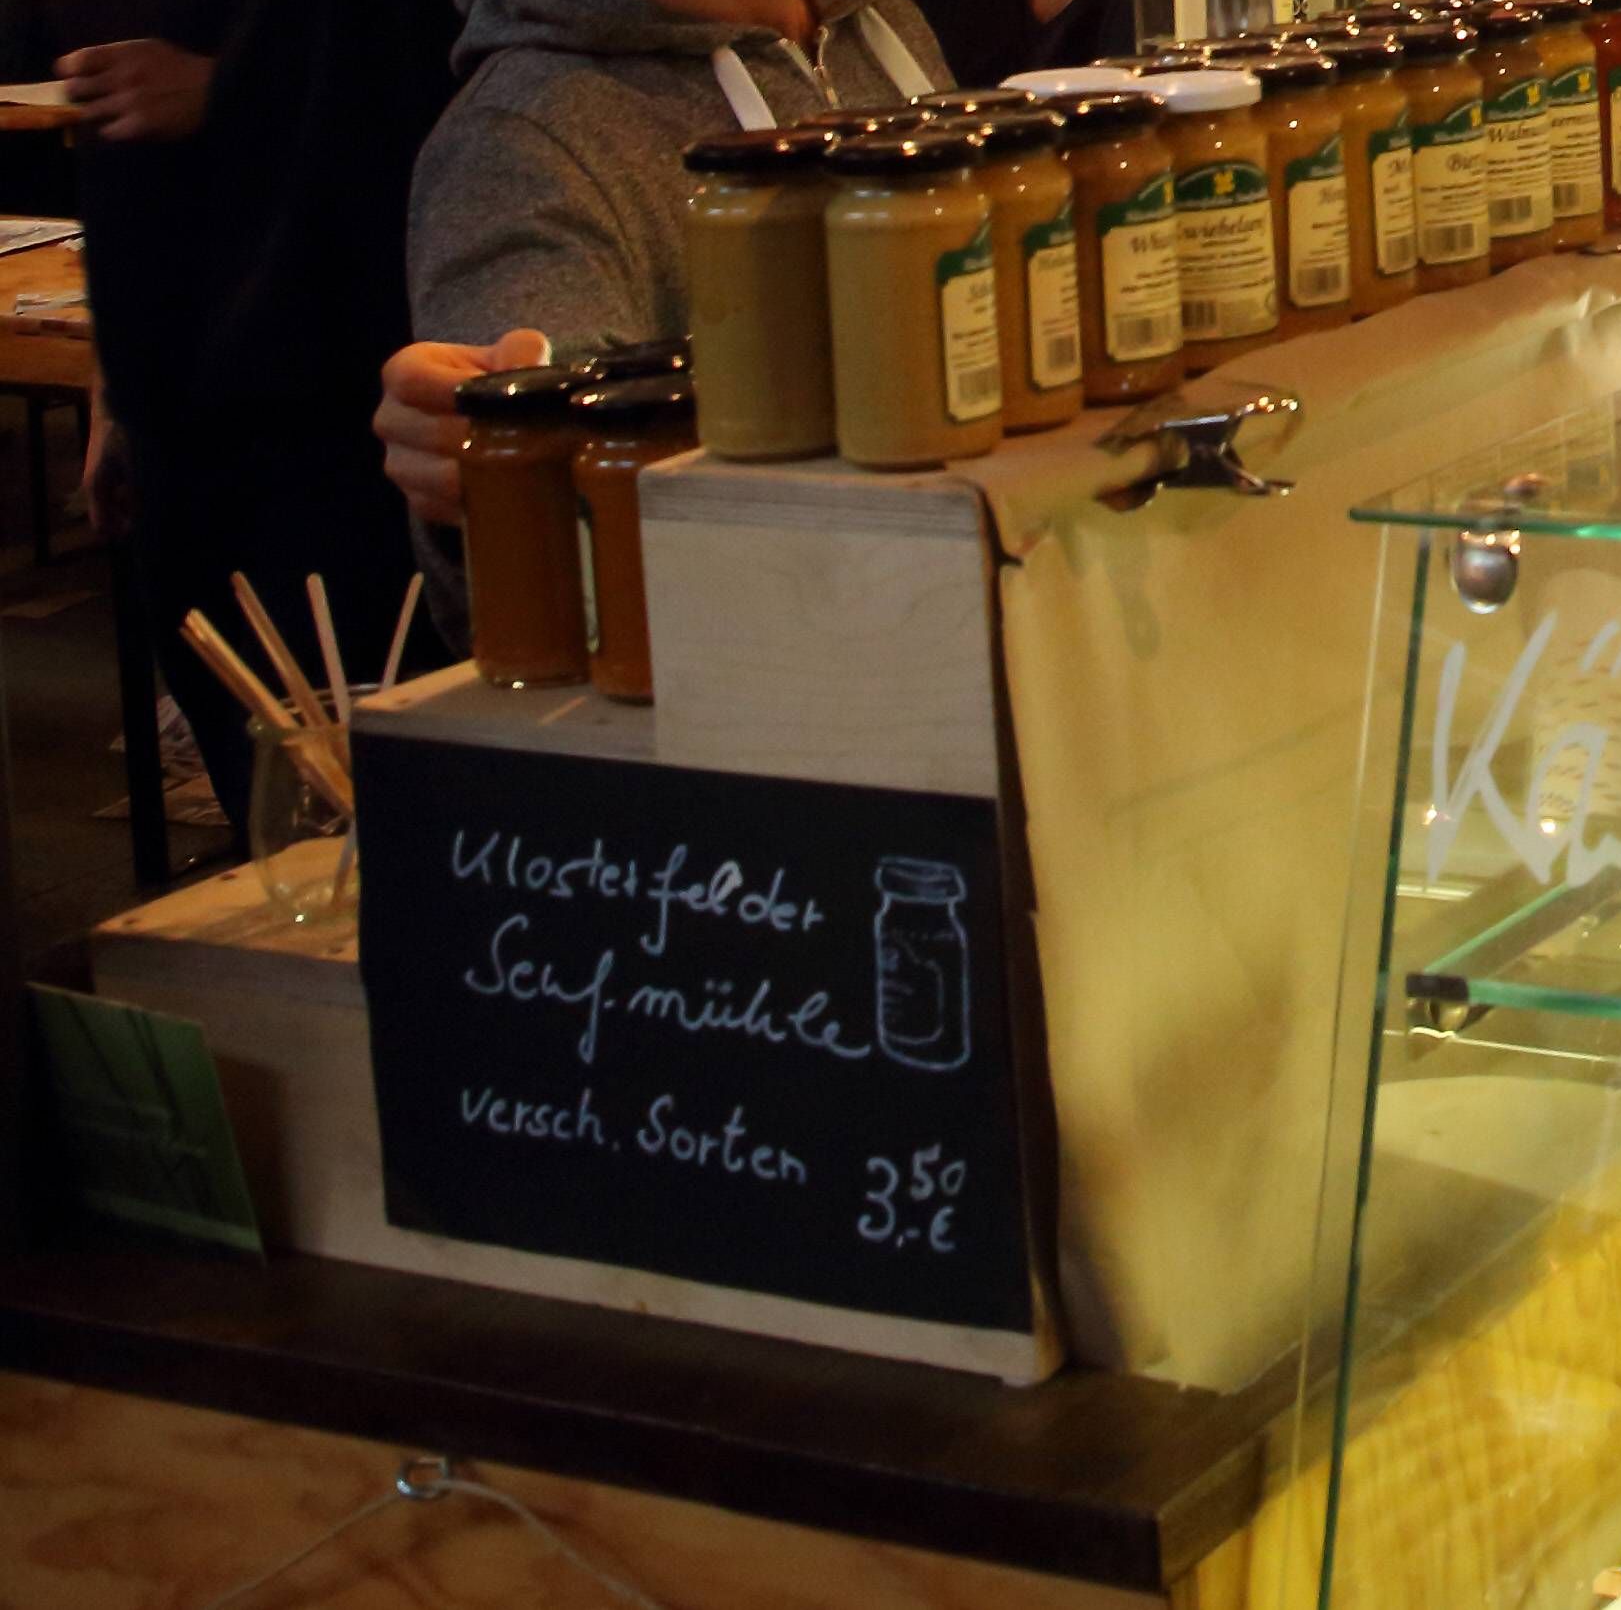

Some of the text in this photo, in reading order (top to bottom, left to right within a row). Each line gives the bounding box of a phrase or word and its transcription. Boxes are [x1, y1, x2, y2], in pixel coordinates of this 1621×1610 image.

[453, 830, 824, 954] Klosterfelder
[461, 1087, 807, 1183] versch. Sorten
